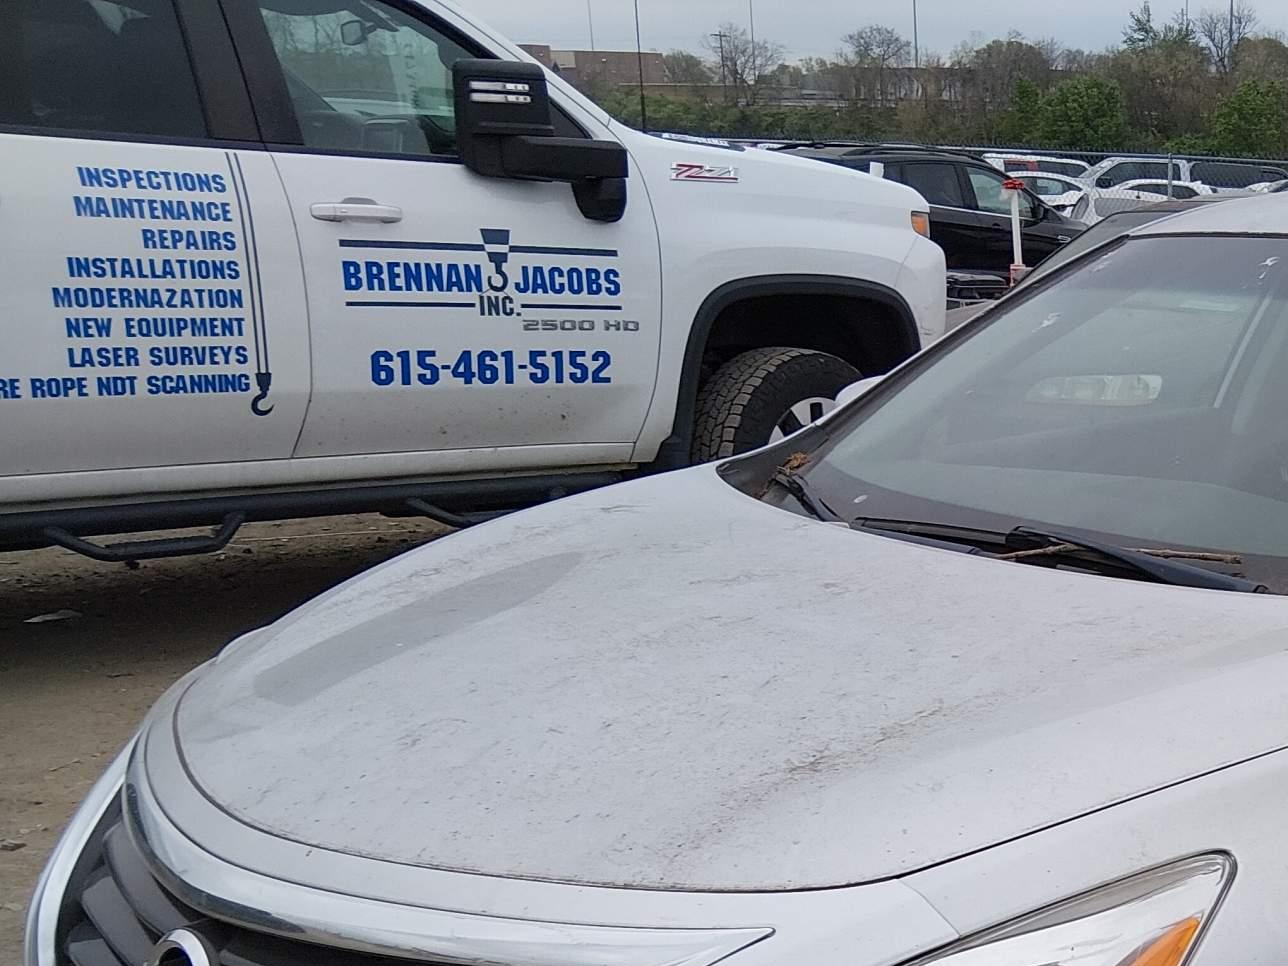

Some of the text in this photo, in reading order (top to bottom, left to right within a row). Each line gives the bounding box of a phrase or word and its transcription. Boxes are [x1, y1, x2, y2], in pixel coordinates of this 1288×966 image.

[76, 166, 227, 193] INSPECTIONS
[73, 195, 232, 222] MAINTENANCE
[141, 228, 236, 251] REPAIRS
[66, 256, 240, 280] INSTALLATIONS
[342, 259, 621, 297] BRENNAN JACOBS
[52, 286, 244, 309] MODERNAZATION
[479, 294, 522, 317] INC.
[65, 317, 245, 338] NEW EQUIPMENT
[522, 319, 640, 332] 2500 HD
[67, 345, 249, 368] LASER SURVEYS
[370, 350, 612, 387] 615-461-5152
[30, 377, 89, 398] ROPE
[97, 375, 137, 396] NDT
[147, 373, 251, 395] SCANNING
